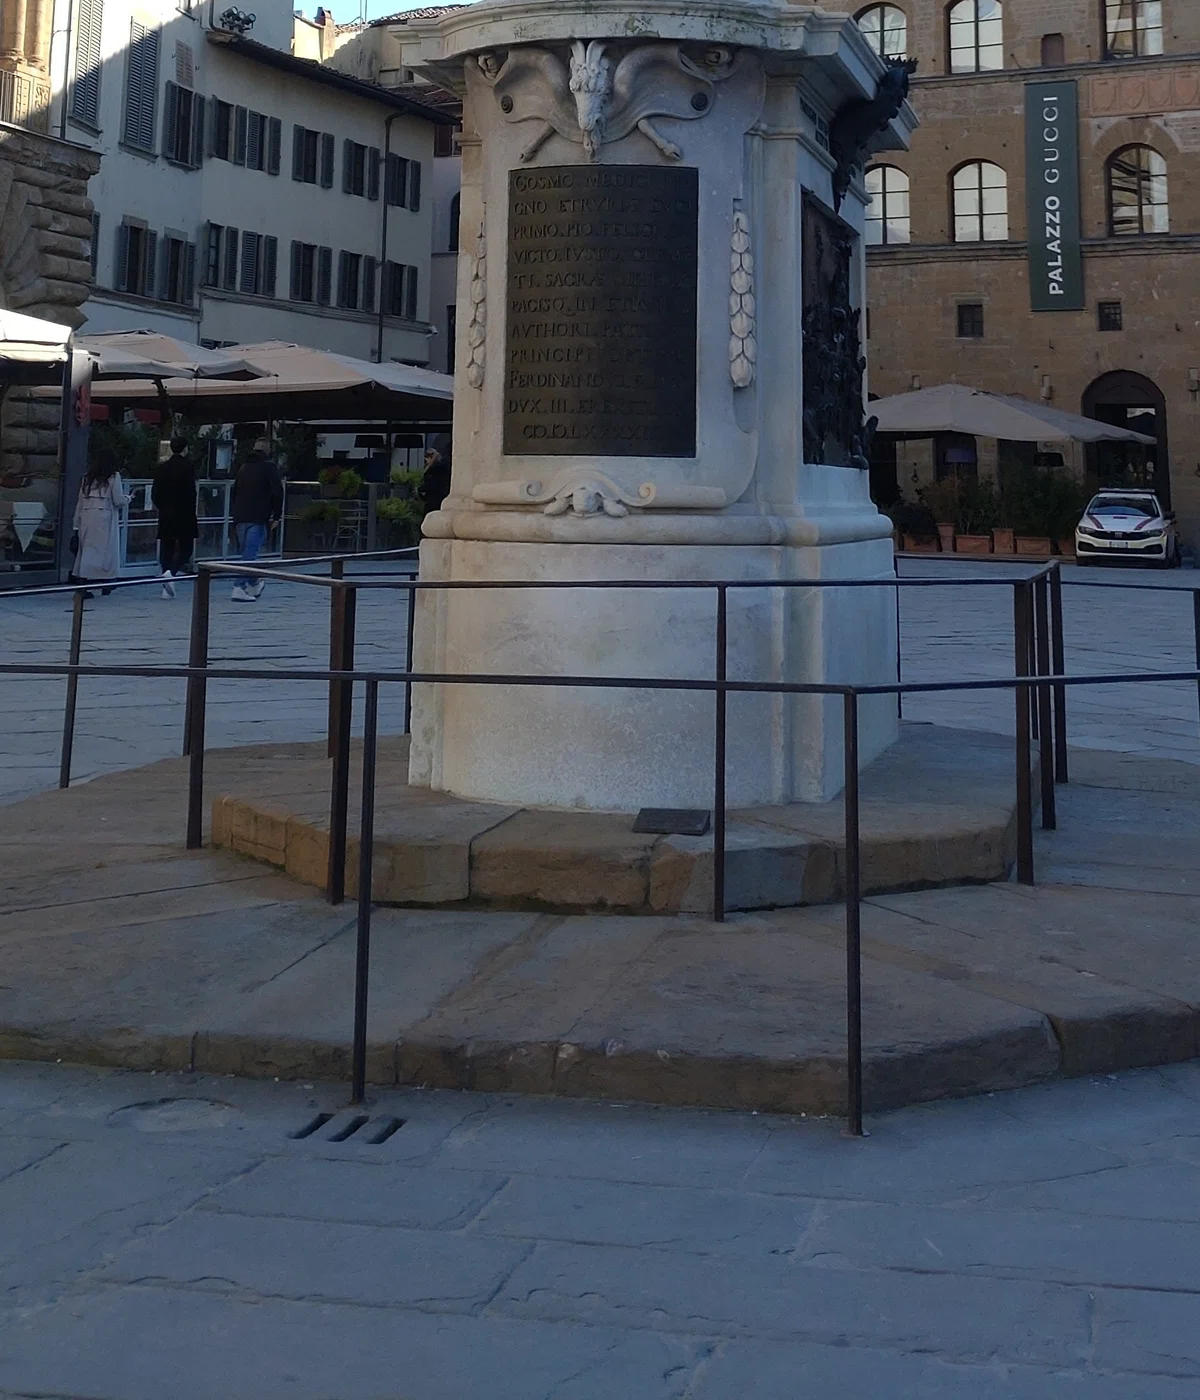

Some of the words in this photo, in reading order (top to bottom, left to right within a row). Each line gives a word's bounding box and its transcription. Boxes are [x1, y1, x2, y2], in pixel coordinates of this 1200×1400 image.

[1043, 96, 1060, 184] GUCCI
[514, 199, 548, 216] GNO
[1045, 196, 1064, 295] PALAZZO
